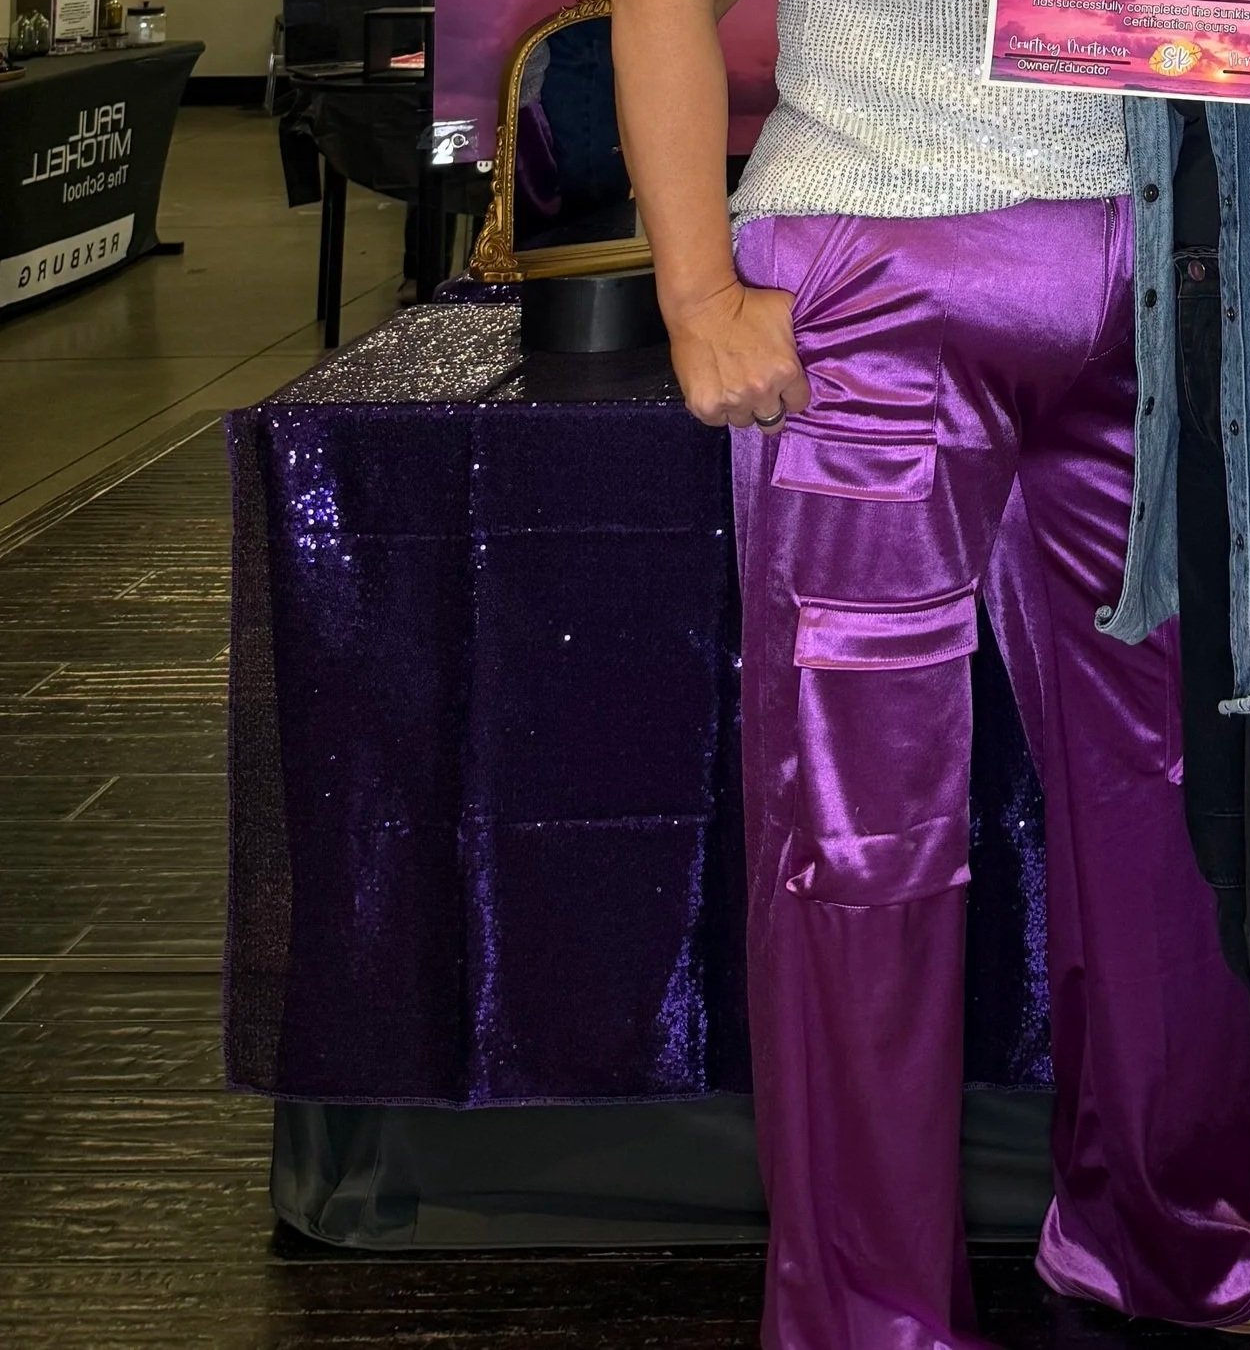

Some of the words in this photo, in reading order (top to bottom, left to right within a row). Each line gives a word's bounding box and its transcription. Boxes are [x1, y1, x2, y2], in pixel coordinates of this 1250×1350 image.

[1127, 2, 1190, 18] completed
[1191, 5, 1211, 17] the
[1123, 16, 1194, 31] Certification
[1195, 21, 1238, 34] Course
[1017, 59, 1111, 76] Owner/Educator
